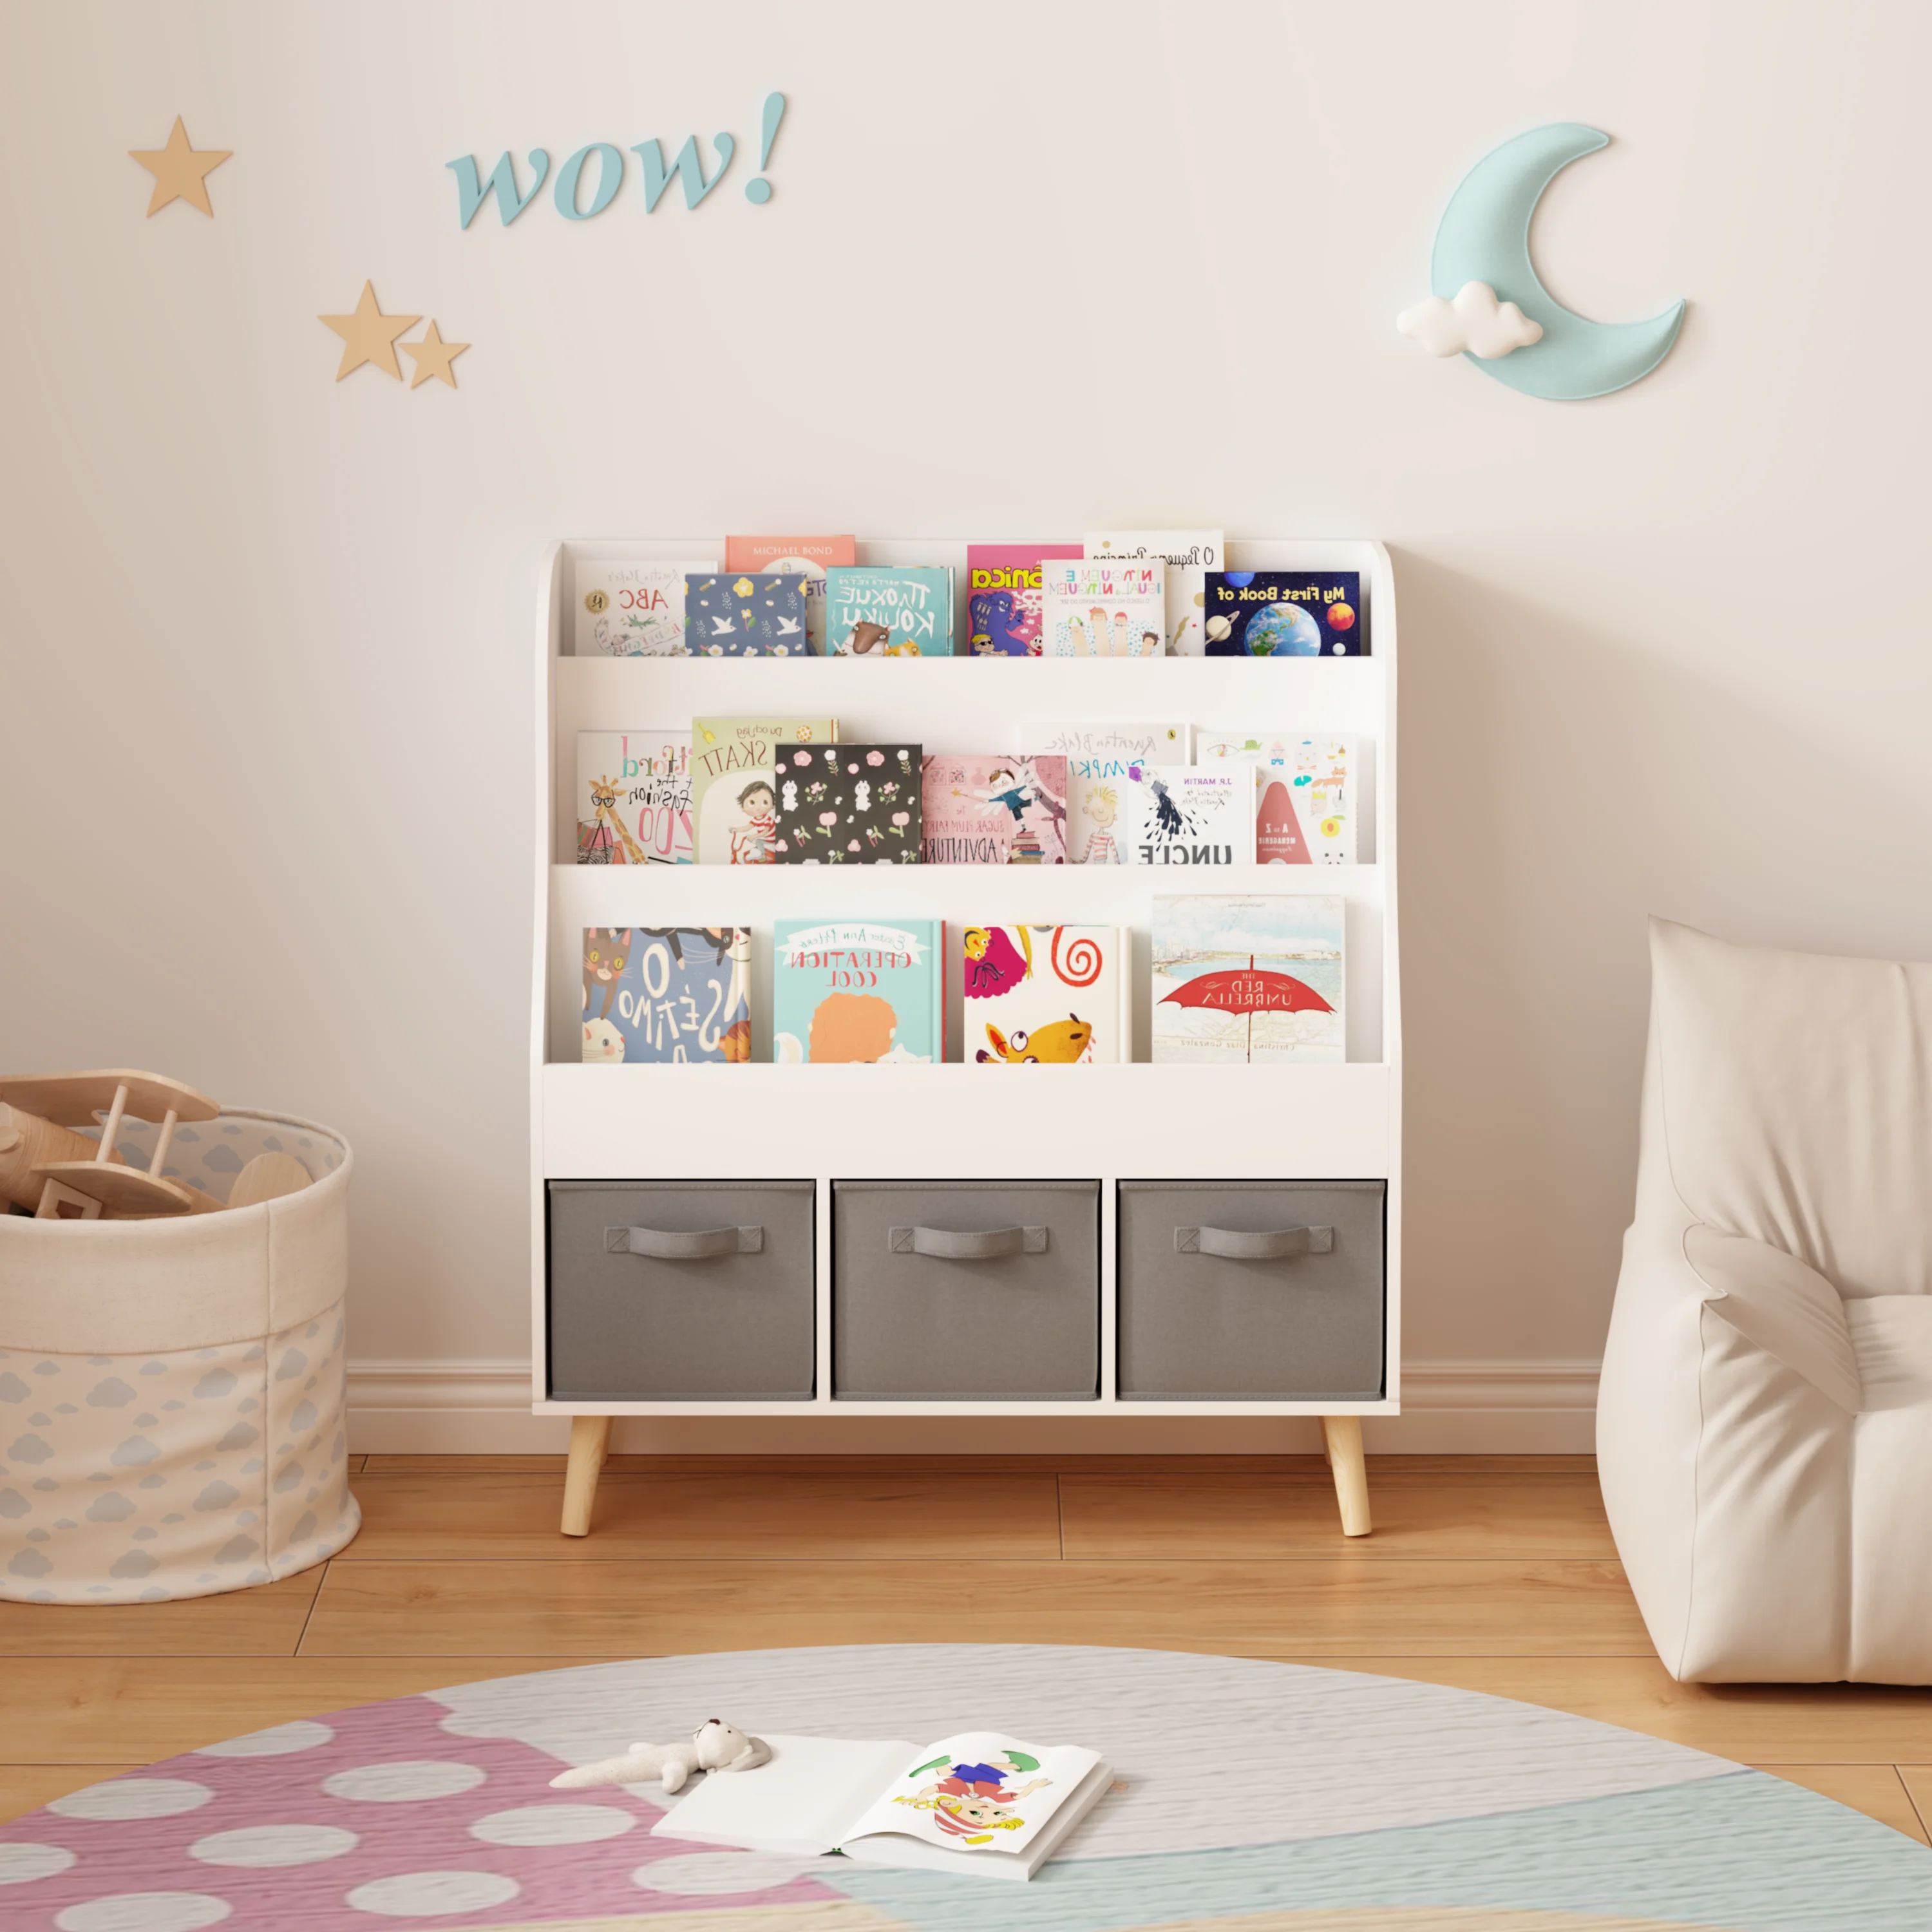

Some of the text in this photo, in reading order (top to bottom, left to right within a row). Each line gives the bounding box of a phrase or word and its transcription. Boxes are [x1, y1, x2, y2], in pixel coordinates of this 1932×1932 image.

[444, 91, 787, 231] wow!
[753, 547, 833, 555] MICHAEL BOND
